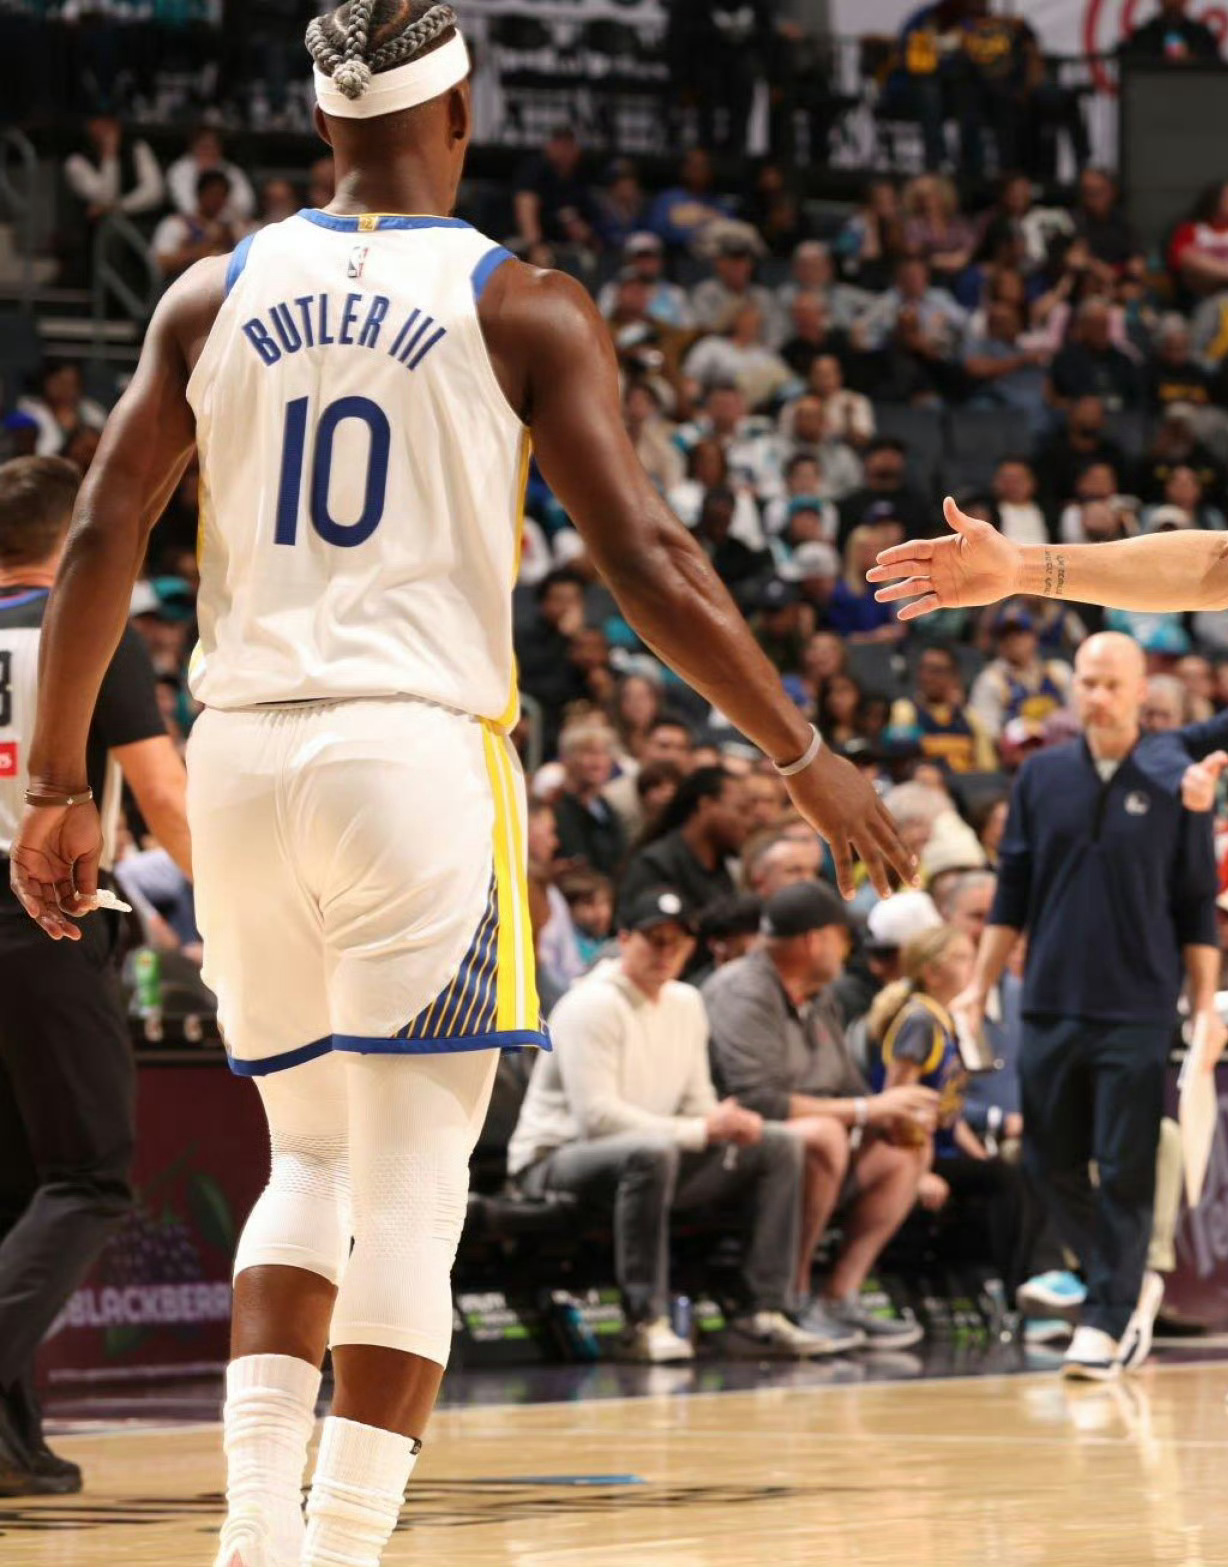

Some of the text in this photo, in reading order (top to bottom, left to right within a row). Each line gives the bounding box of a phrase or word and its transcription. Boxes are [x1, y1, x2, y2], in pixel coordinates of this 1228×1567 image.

[241, 293, 447, 371] BUTLER III
[274, 395, 391, 548] 10
[67, 1282, 233, 1328] BLACKBERR
